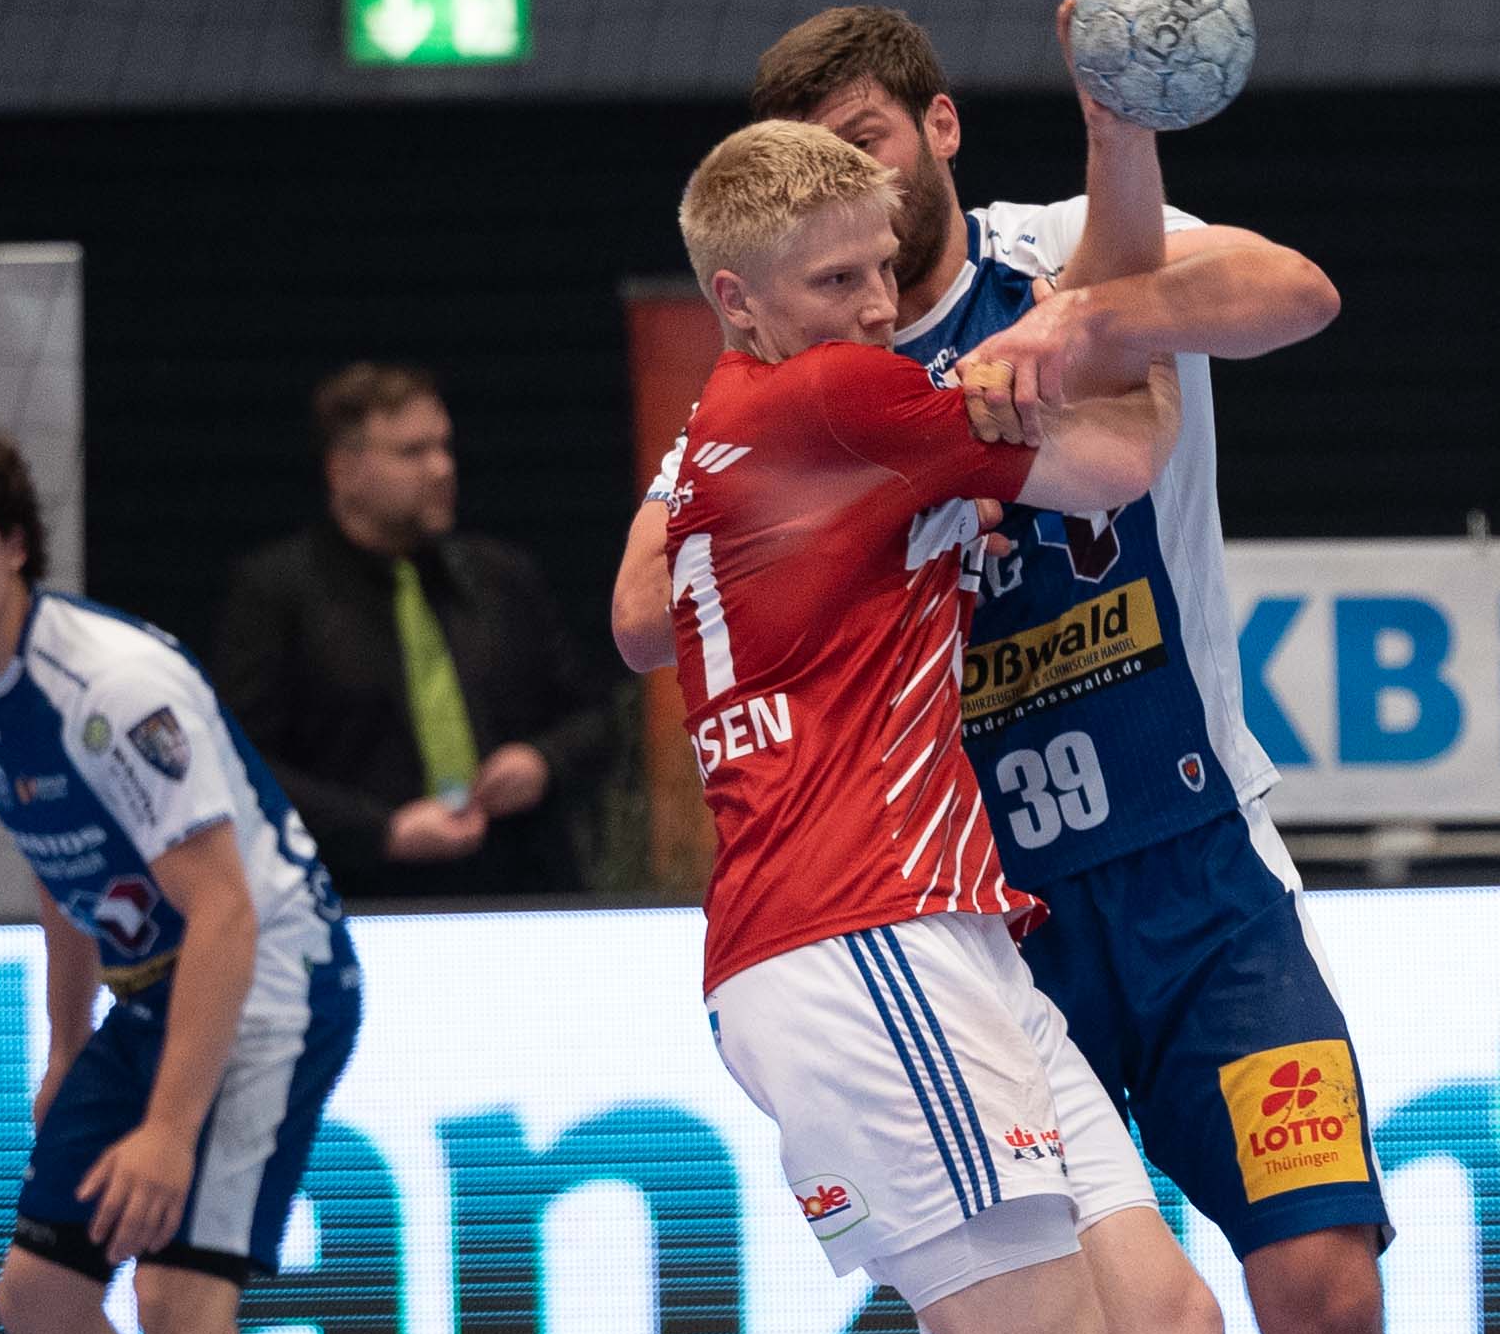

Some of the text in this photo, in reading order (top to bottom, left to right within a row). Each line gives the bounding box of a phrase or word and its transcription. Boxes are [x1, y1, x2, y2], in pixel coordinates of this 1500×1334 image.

[962, 591, 1128, 695] Oßwald
[691, 692, 793, 783] SEN
[995, 730, 1110, 851] 39
[1250, 1116, 1344, 1158] LOTTO
[1264, 1149, 1340, 1176] Thüringen
